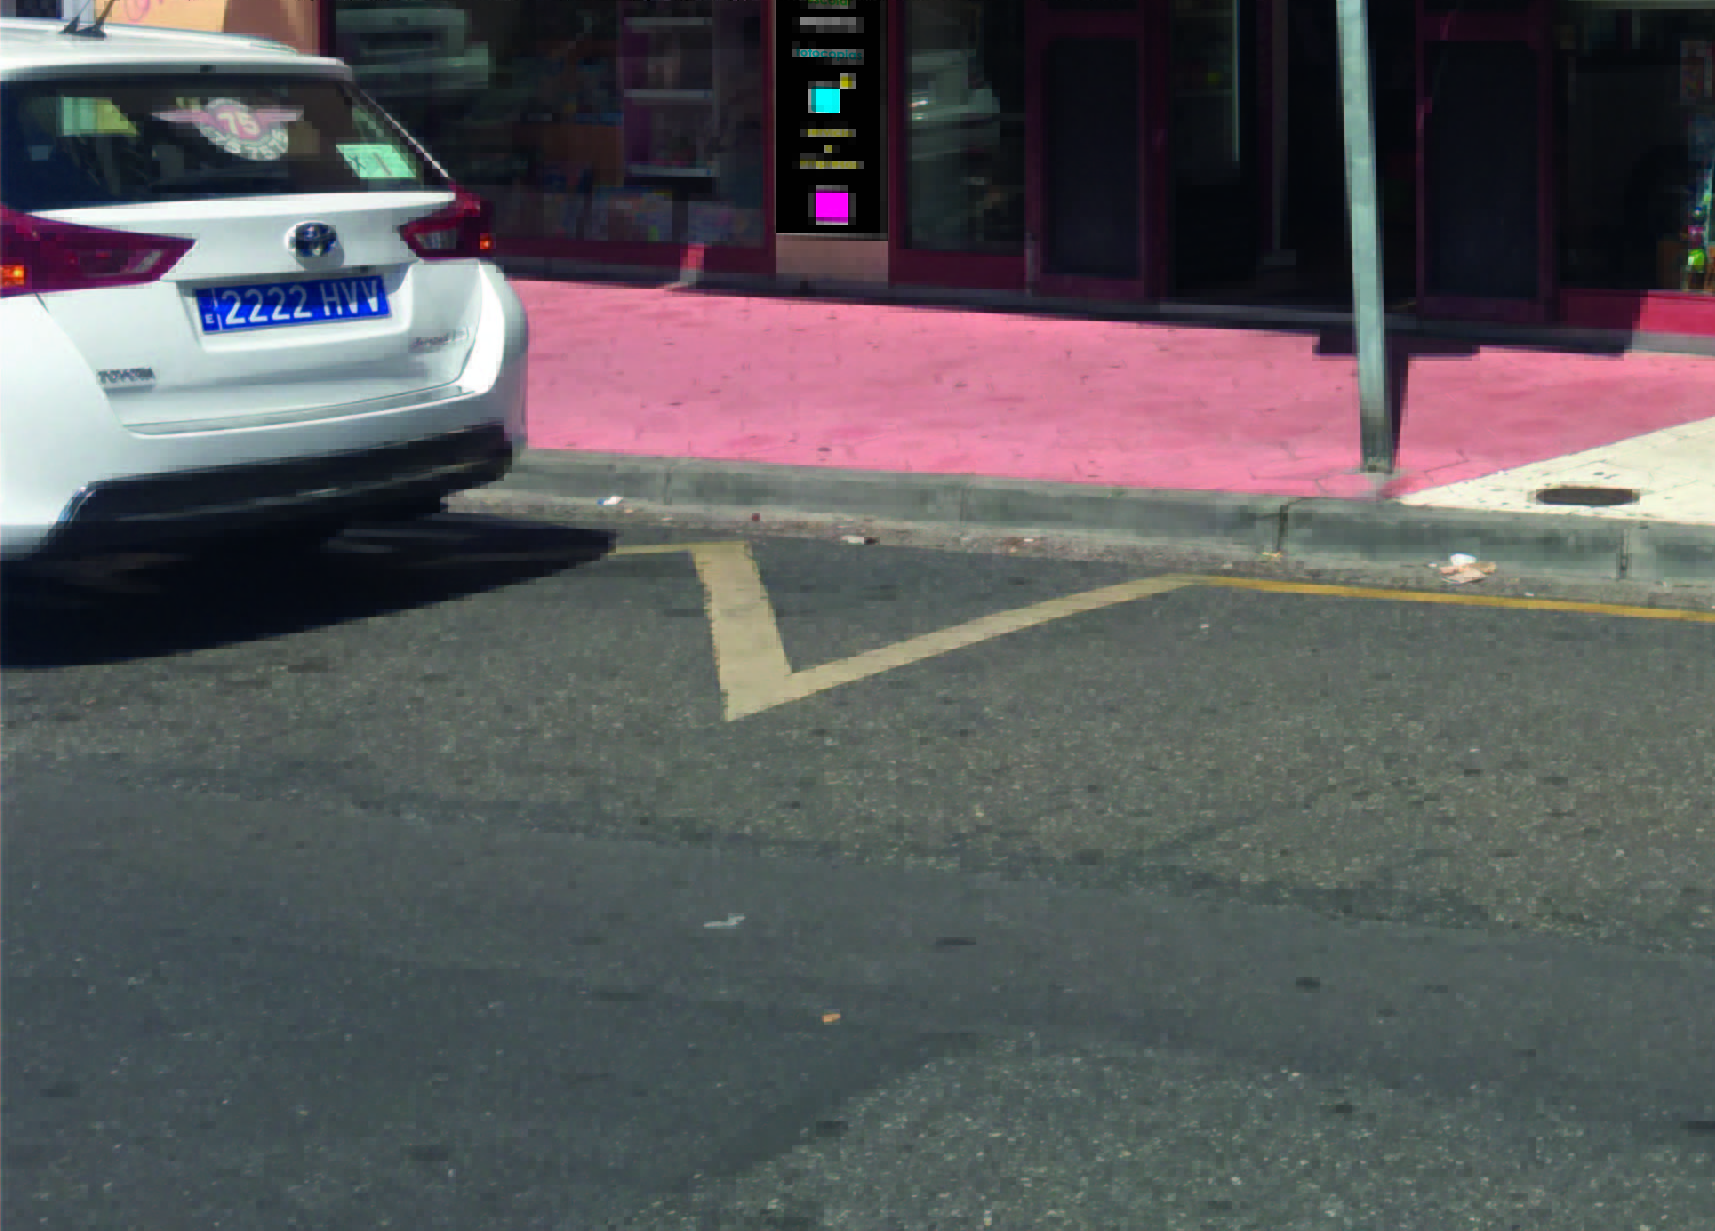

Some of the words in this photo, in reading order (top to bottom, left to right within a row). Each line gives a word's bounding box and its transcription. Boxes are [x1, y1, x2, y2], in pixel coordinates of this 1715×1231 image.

[796, 47, 863, 62] fotocopias
[216, 112, 261, 137] 75
[204, 313, 215, 324] E
[222, 284, 313, 326] 2222
[319, 280, 379, 317] HVV
